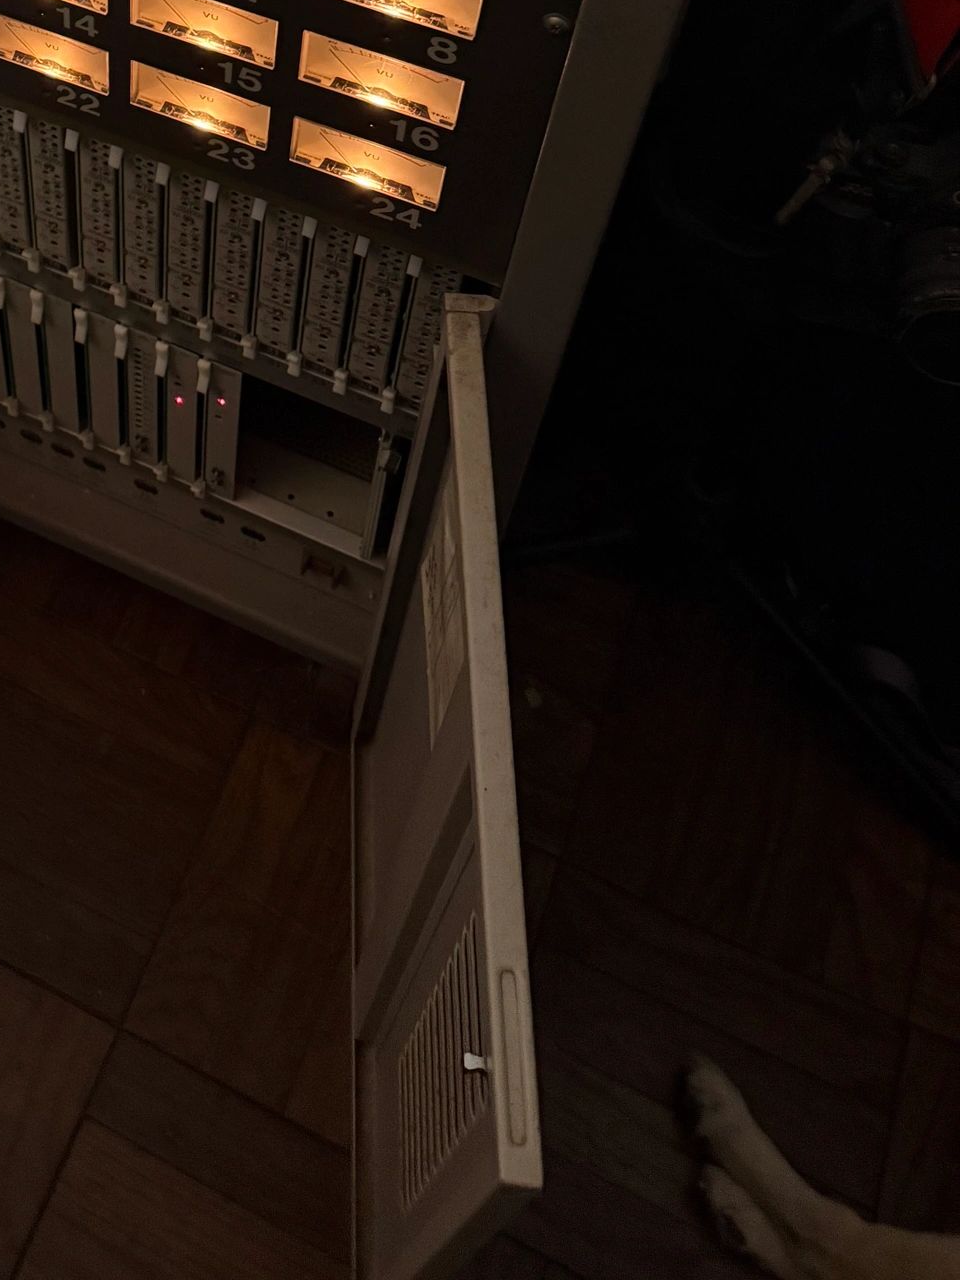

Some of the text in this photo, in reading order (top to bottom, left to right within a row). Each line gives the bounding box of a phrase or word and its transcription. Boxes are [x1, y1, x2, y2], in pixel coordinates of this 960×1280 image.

[56, 6, 99, 38] 14
[202, 10, 219, 22] VU
[44, 41, 60, 51] VU
[426, 36, 458, 65] 8
[217, 61, 264, 93] 15
[376, 68, 394, 79] VU
[56, 84, 101, 117] 22
[199, 93, 214, 103] VU
[389, 119, 441, 152] 16
[206, 138, 256, 171] 23
[363, 151, 380, 161] VU
[369, 196, 423, 230] 24
